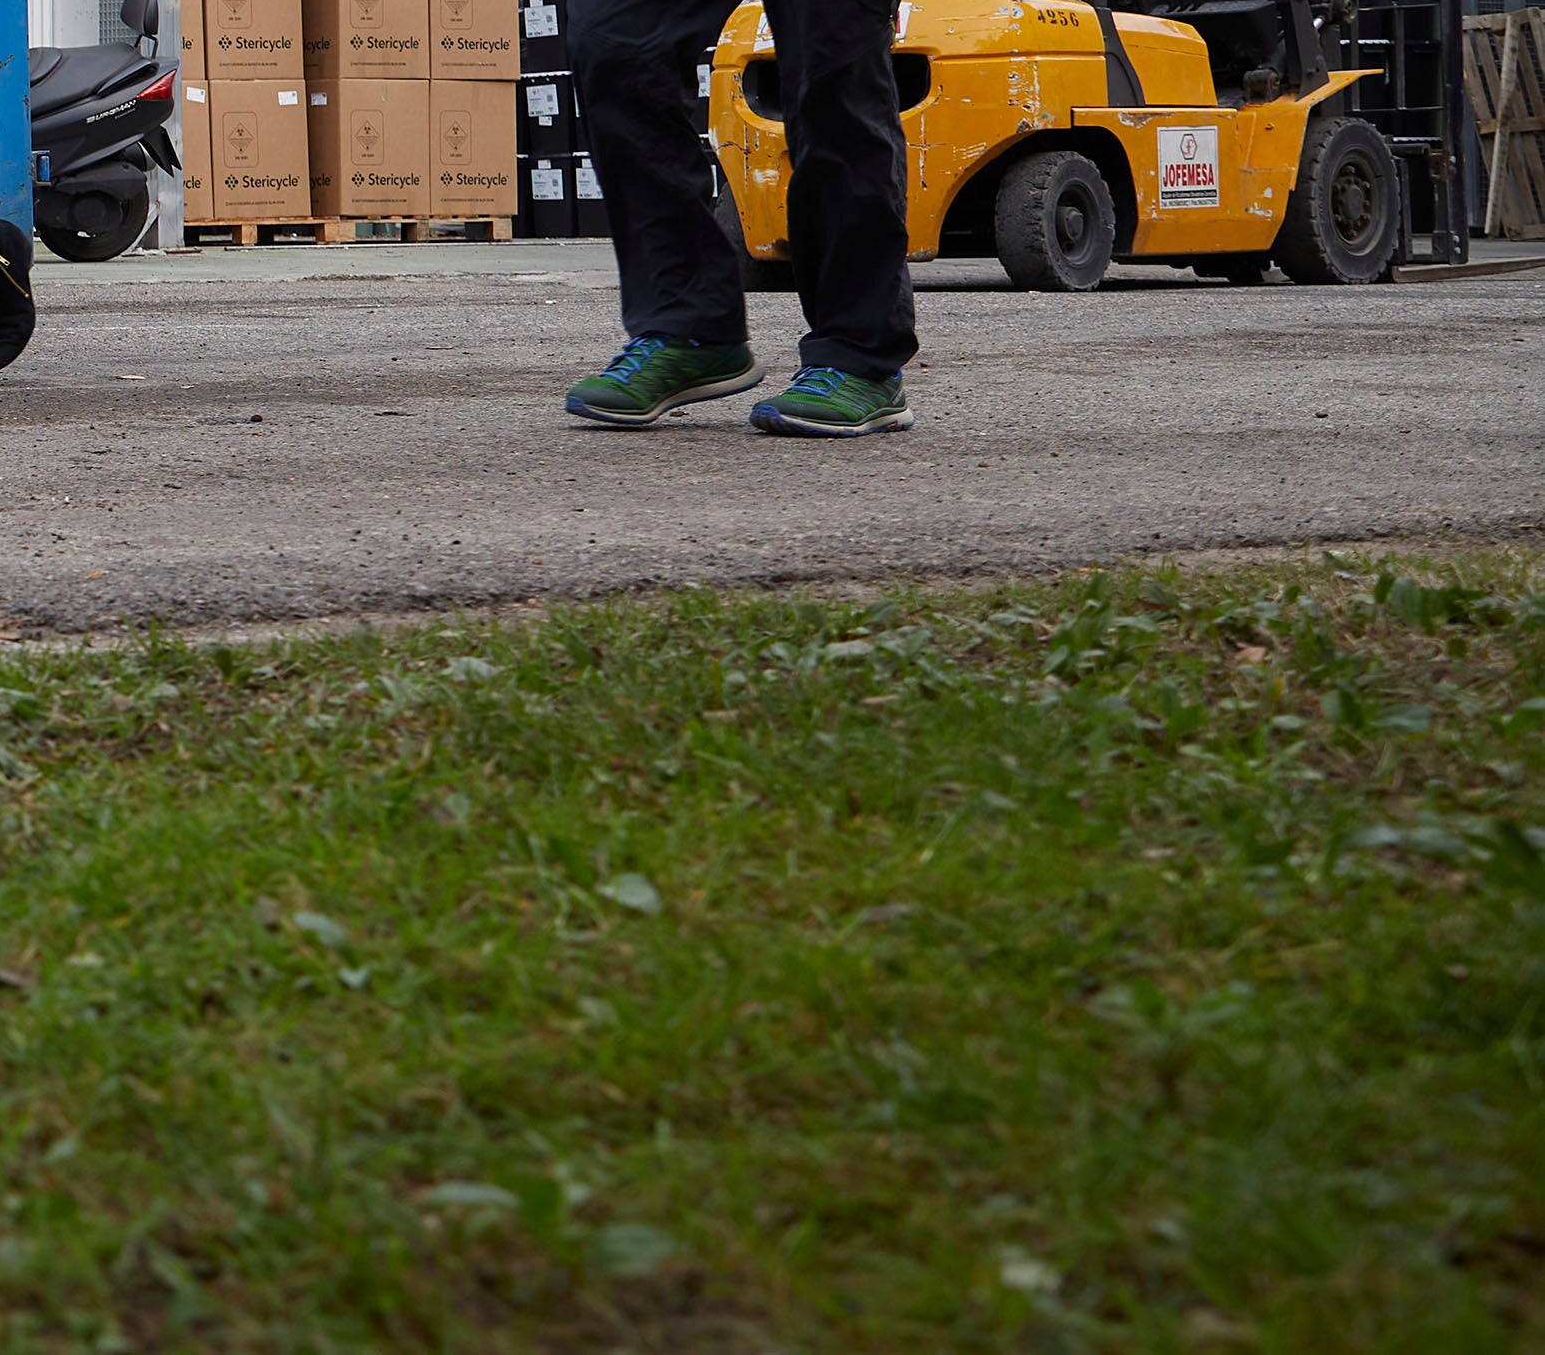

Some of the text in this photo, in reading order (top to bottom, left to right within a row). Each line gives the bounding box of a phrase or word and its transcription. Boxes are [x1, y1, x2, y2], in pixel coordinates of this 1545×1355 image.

[1037, 9, 1079, 27] 4256
[236, 36, 292, 52] Stericycle
[367, 36, 419, 52] Stericycle
[457, 37, 510, 54] Stericycle
[242, 174, 299, 191] Stericycle
[368, 172, 420, 189] Stericycle
[456, 172, 508, 189] Stericycle
[1162, 163, 1215, 188] JOFEMESA
